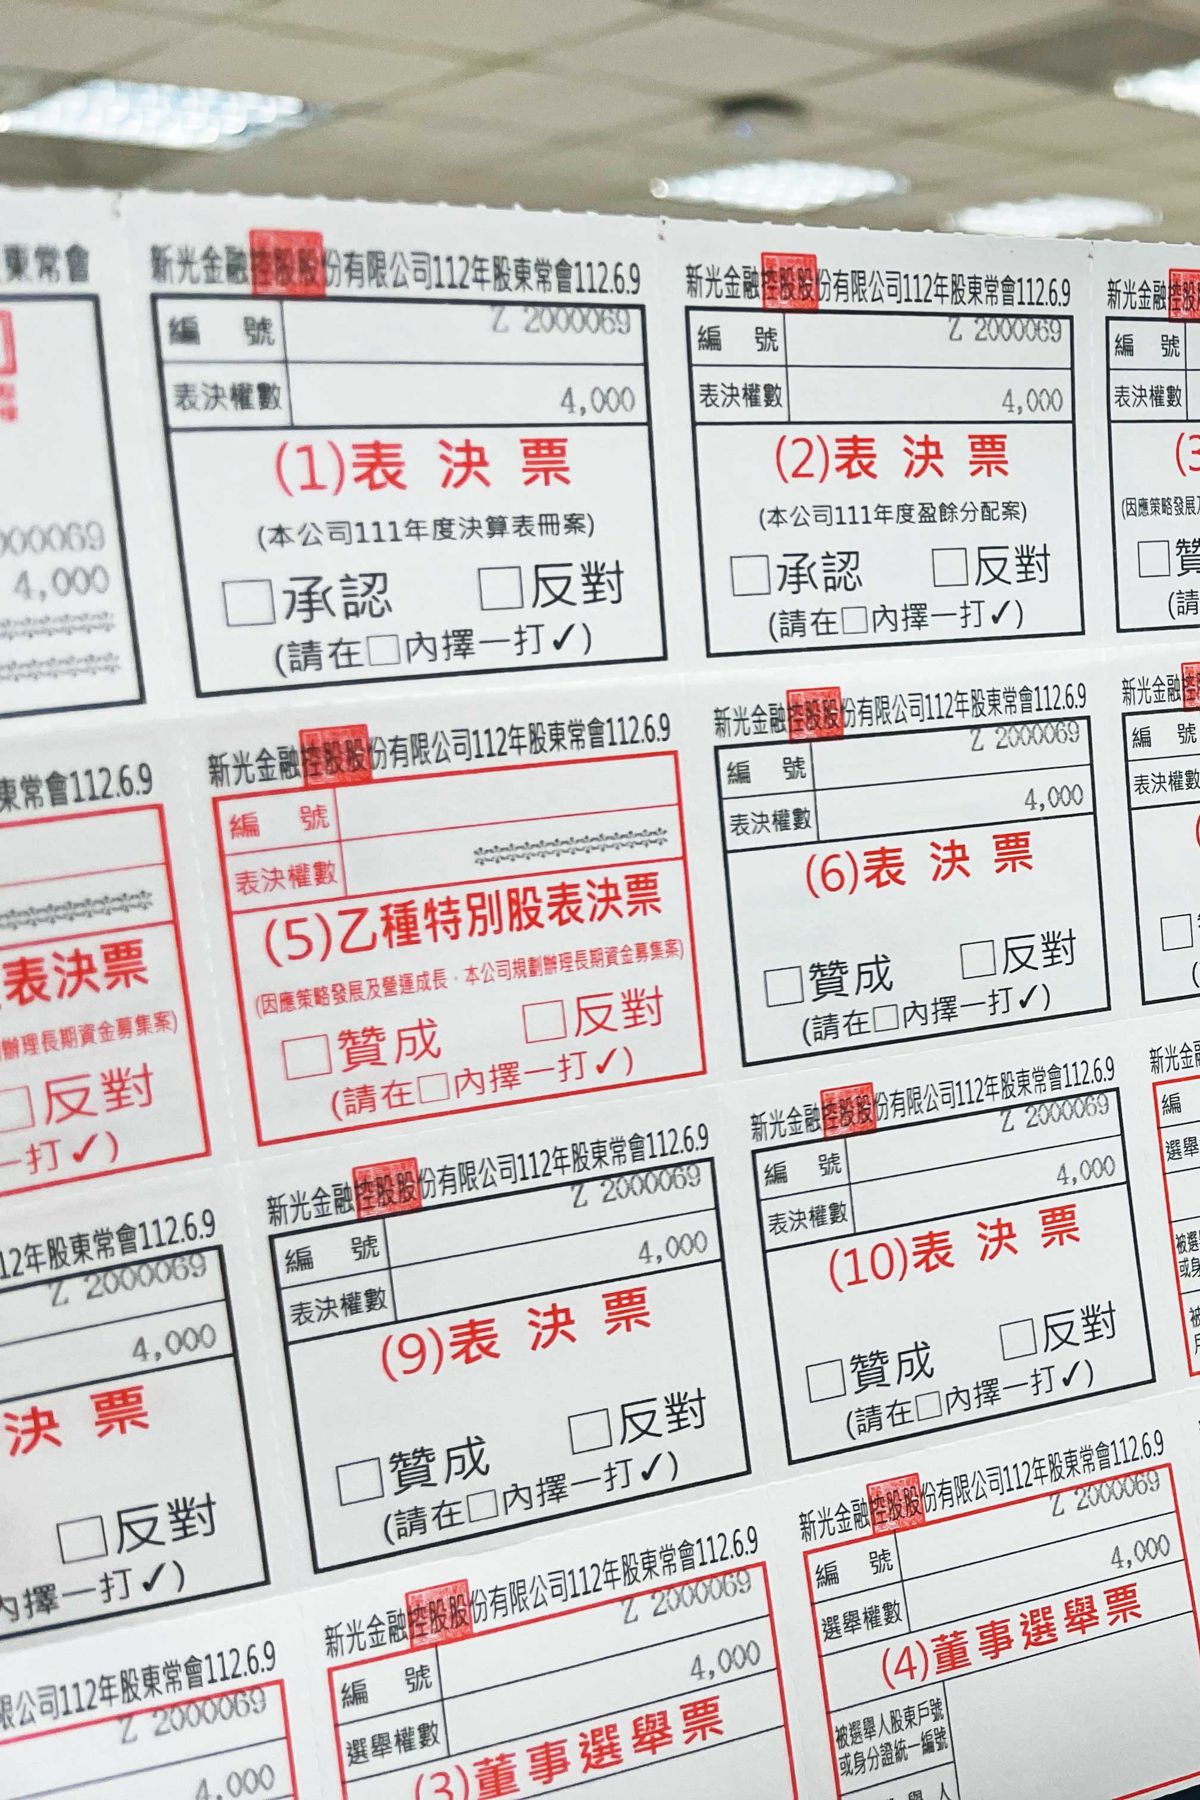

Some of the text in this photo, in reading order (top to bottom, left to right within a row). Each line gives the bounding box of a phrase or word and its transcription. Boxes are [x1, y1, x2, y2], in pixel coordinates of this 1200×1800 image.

[523, 305, 631, 335] 2000069
[974, 319, 1061, 342] 2000069
[173, 383, 282, 411] 表決權數
[561, 385, 636, 416] 4,000
[699, 383, 783, 408] 表決權數
[1001, 388, 1063, 415] 4,000
[1114, 385, 1182, 409] 表決權數
[275, 437, 572, 498] (1)表決票
[775, 434, 1009, 484] (2)表決票
[257, 512, 594, 552] (本公司111年度決算表冊案)
[759, 501, 1027, 531] (本公司111年度盈餘分配案)
[13, 564, 110, 602] 4,000
[531, 560, 624, 608] 反對
[777, 550, 863, 594] 承認
[975, 543, 1050, 586] 反對
[282, 572, 393, 623] 承認
[995, 720, 1080, 750] 2000069
[1025, 784, 1084, 811] 4,000
[1133, 768, 1200, 796] 表決權數
[730, 807, 812, 837] 表決權數
[236, 860, 338, 896] 表決權數
[806, 831, 1034, 899] (6)表決票
[264, 871, 662, 967] (5)乙種特別股表決票
[2, 938, 149, 1007] 表決票
[1002, 928, 1076, 975] 反對
[809, 954, 894, 1002] 贊成
[574, 985, 664, 1038] 反對
[337, 1017, 442, 1073] 贊成
[44, 1061, 154, 1125] 反對
[1026, 1094, 1110, 1129] 2000069
[601, 1165, 702, 1204] 2000069
[1057, 1155, 1116, 1187] 4,000
[768, 1202, 848, 1236] 表決權數
[638, 1229, 709, 1265] 4,000
[829, 1203, 1081, 1293] (10)表決票
[86, 1254, 207, 1300] 2000069
[290, 1286, 389, 1327] 表決權數
[1043, 1301, 1116, 1353] 反對
[133, 1324, 217, 1363] 4,000
[381, 1286, 652, 1382] (9)表決票
[850, 1340, 935, 1394] 贊成
[3, 1385, 149, 1457] 決票
[619, 1388, 707, 1445] 反對
[389, 1435, 490, 1495] 贊成
[1076, 1470, 1161, 1511] 2000069
[117, 1492, 217, 1554] 反對
[1110, 1534, 1171, 1570] 4,000
[653, 1571, 752, 1618] 2000069
[821, 1599, 903, 1642] 選舉權數
[882, 1582, 1143, 1689] (4)董事選舉票
[690, 1641, 762, 1681] 4,000
[152, 1688, 267, 1736] 2000069
[835, 1698, 945, 1750] 被選舉人股東戶號
[346, 1720, 441, 1767] 選舉權數
[414, 1695, 724, 1800] (3)董事選舉票
[839, 1726, 949, 1777] 或身分證統一編號
